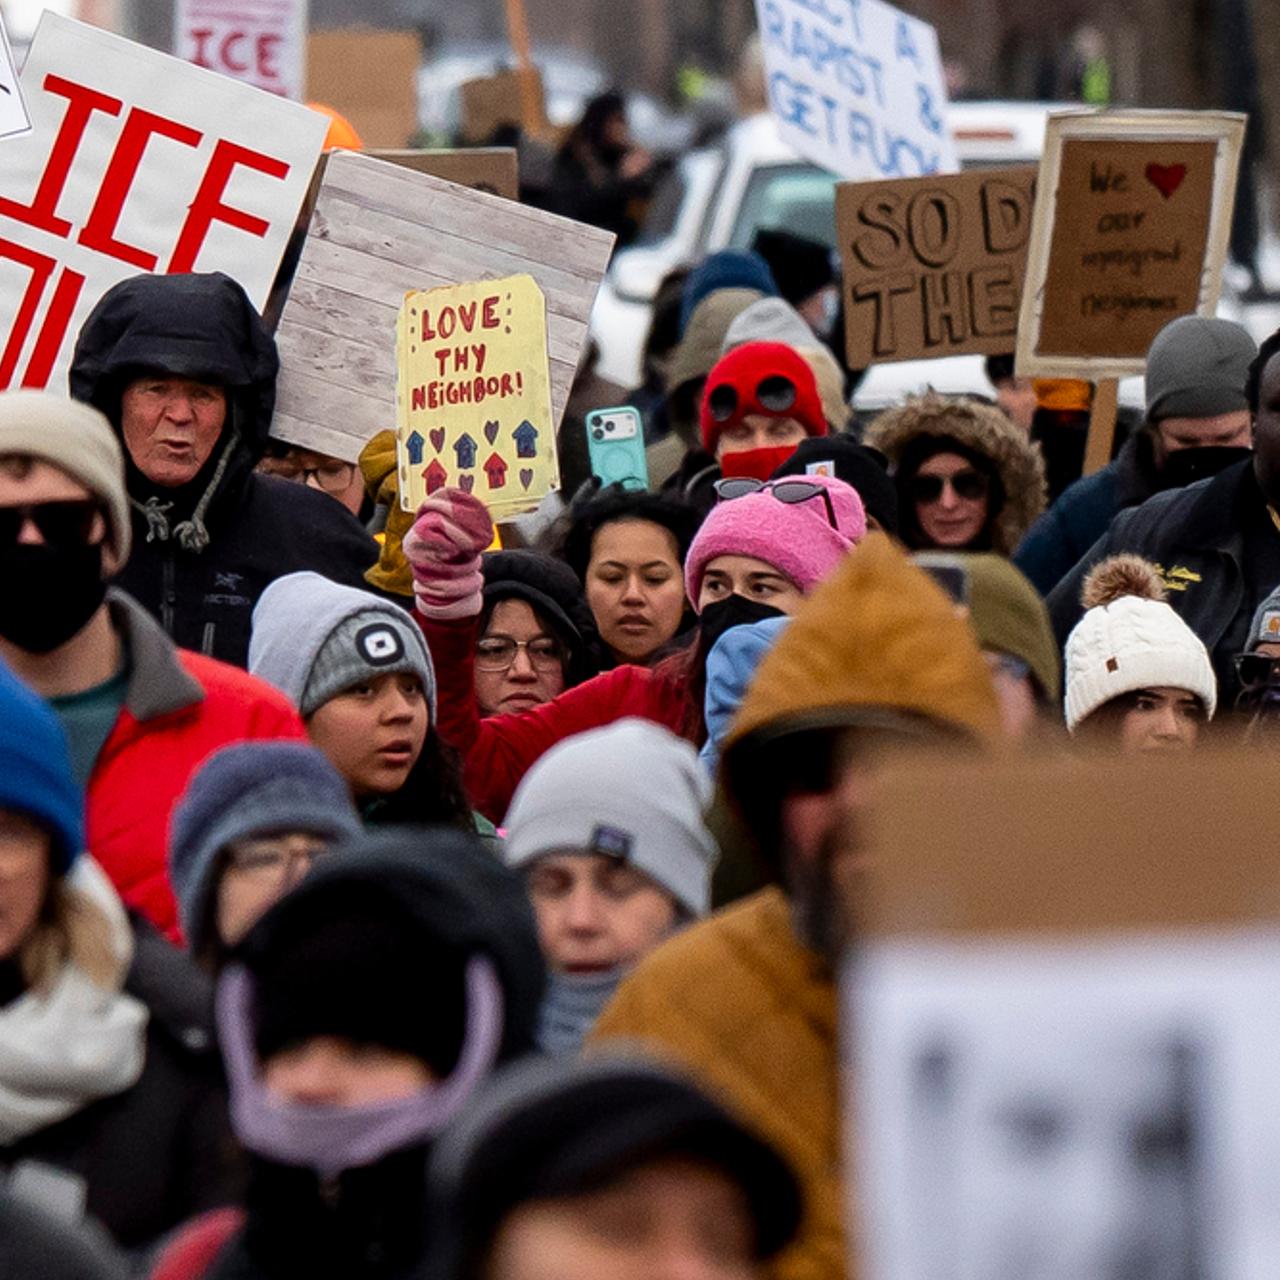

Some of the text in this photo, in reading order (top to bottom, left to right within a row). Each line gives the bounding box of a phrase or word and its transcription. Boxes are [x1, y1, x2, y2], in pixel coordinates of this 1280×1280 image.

[188, 27, 283, 79] ICE
[851, 188, 961, 272] SO
[421, 295, 501, 343] LOVE
[435, 343, 487, 377] THY
